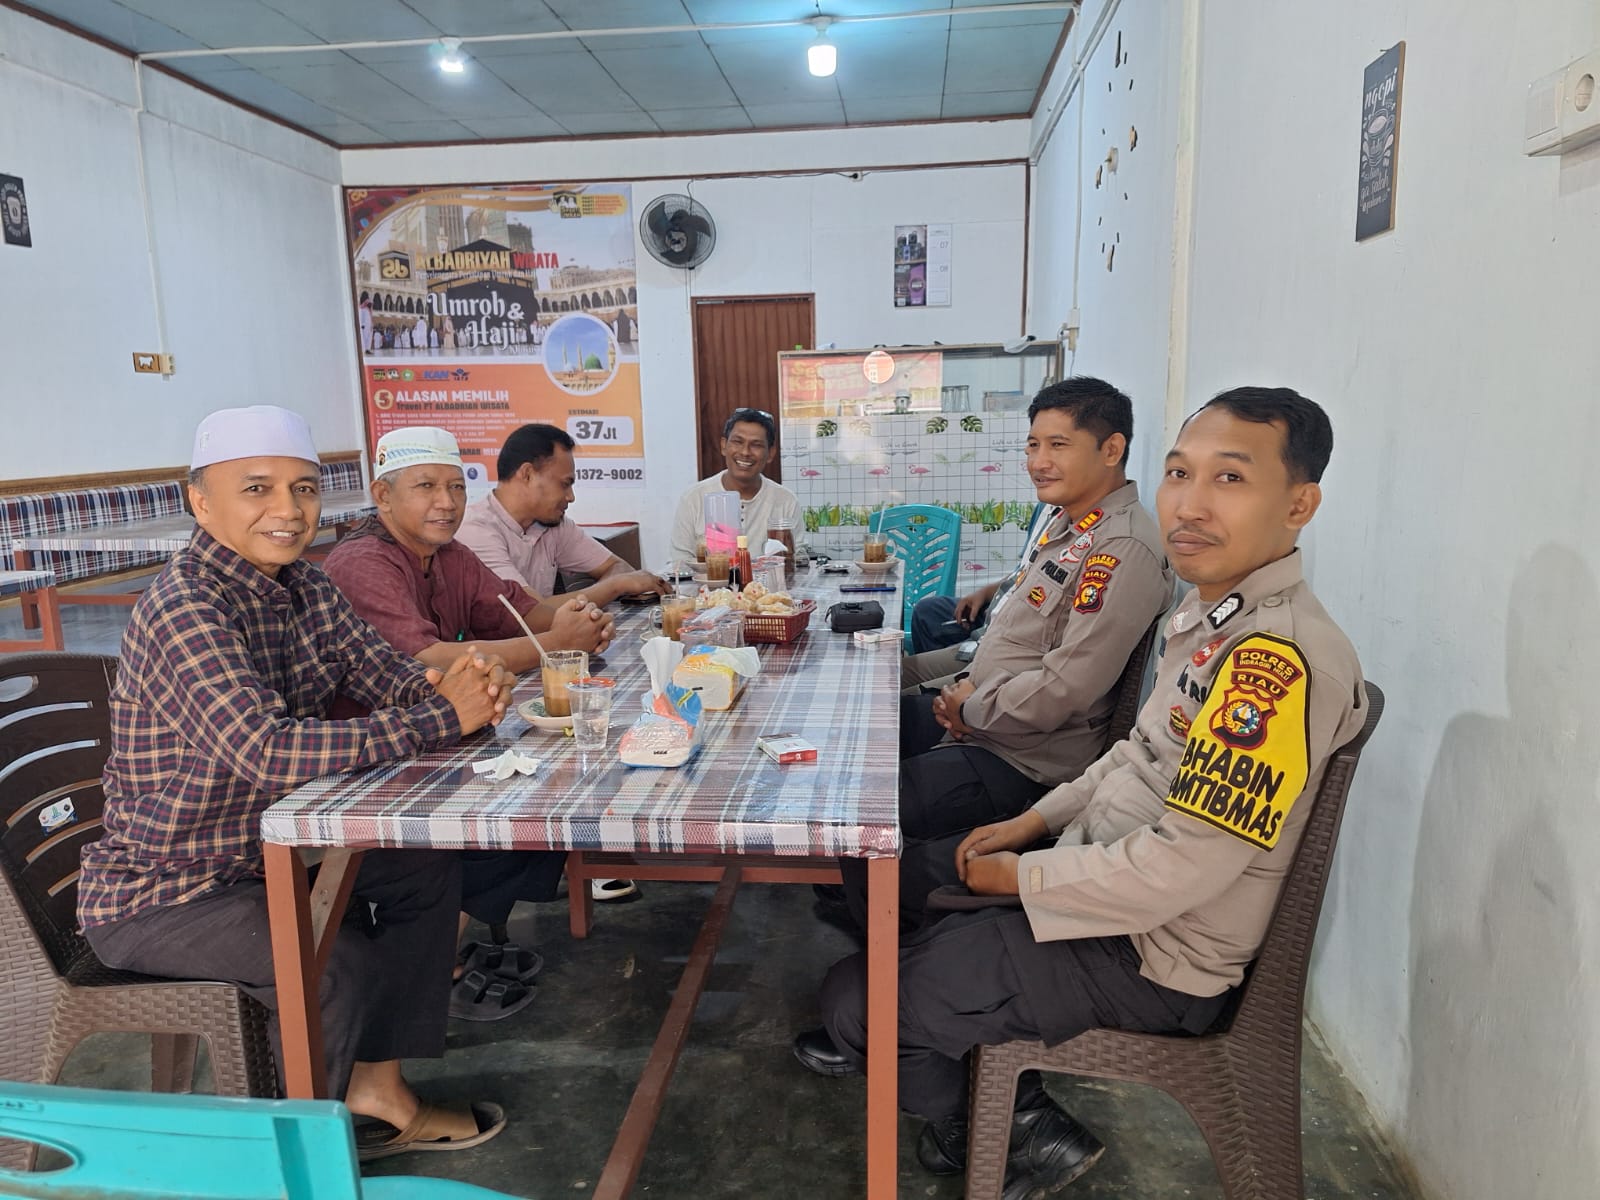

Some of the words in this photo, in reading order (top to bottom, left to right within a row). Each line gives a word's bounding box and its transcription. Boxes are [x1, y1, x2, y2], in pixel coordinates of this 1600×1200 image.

[427, 291, 506, 318] Umroh
[507, 302, 525, 320] &
[464, 315, 517, 350] Haji
[396, 390, 448, 402] ALASAN
[451, 390, 509, 402] MEMILIH
[575, 468, 643, 481] 1372-9002
[1087, 555, 1117, 567] POLRES
[1085, 571, 1108, 579] RIAU
[1239, 659, 1272, 670] INDRAGIRI
[1240, 651, 1295, 677] POLRES
[1237, 674, 1281, 694] RIAU
[1169, 767, 1283, 842] AMTIBMAS
